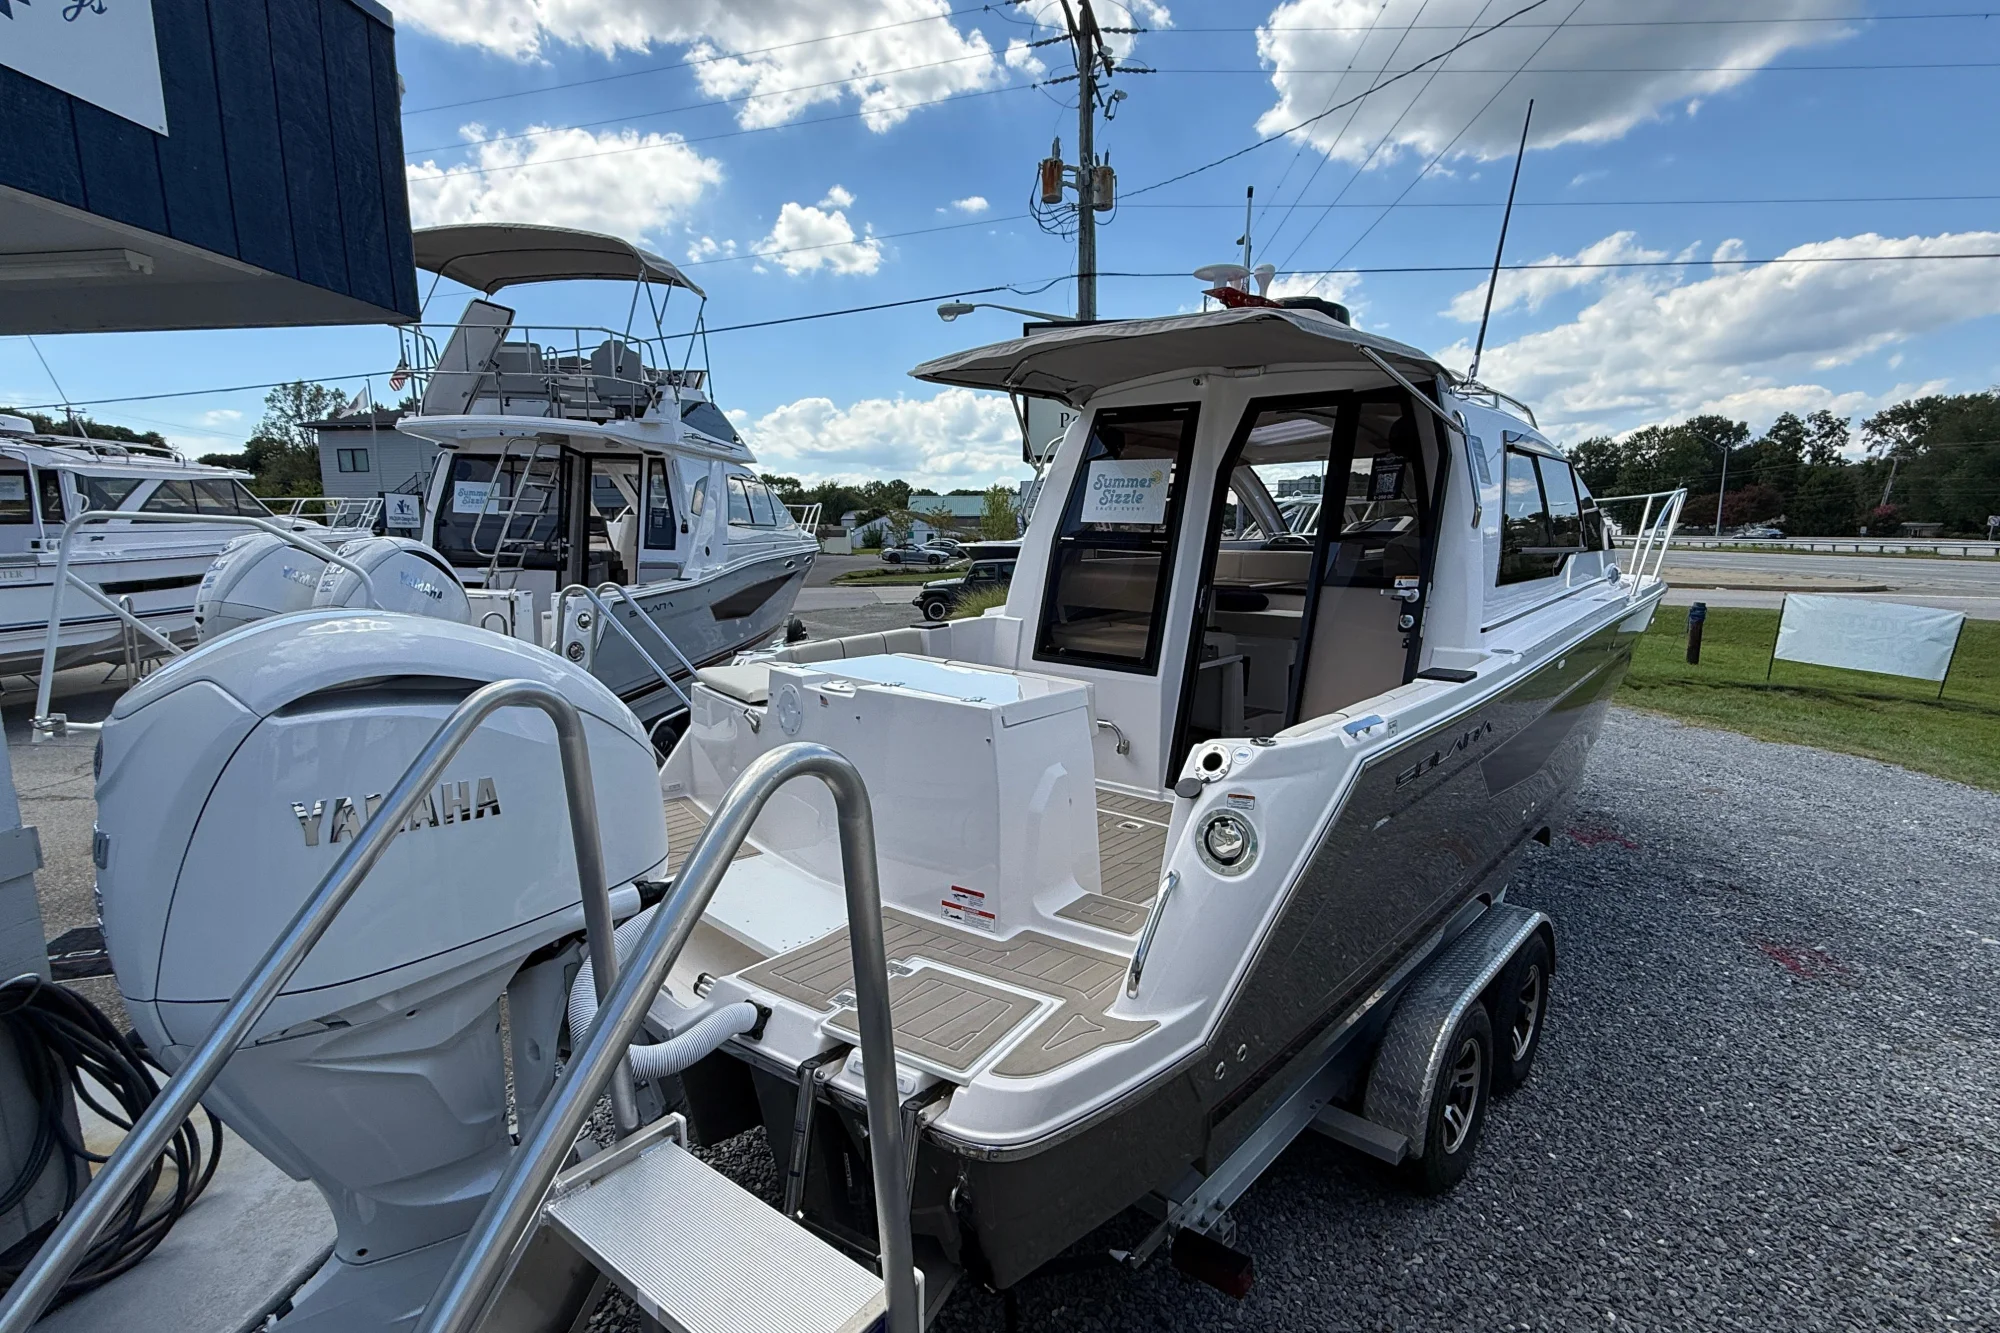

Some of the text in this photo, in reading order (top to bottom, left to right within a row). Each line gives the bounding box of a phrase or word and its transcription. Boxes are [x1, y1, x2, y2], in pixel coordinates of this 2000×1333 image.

[1093, 474, 1155, 490] Summer
[458, 488, 489, 497] Summe
[462, 495, 485, 504] Sizzl
[1099, 489, 1144, 505] Sizzle
[283, 565, 317, 590] YAMA
[400, 571, 443, 600] YAMAHA
